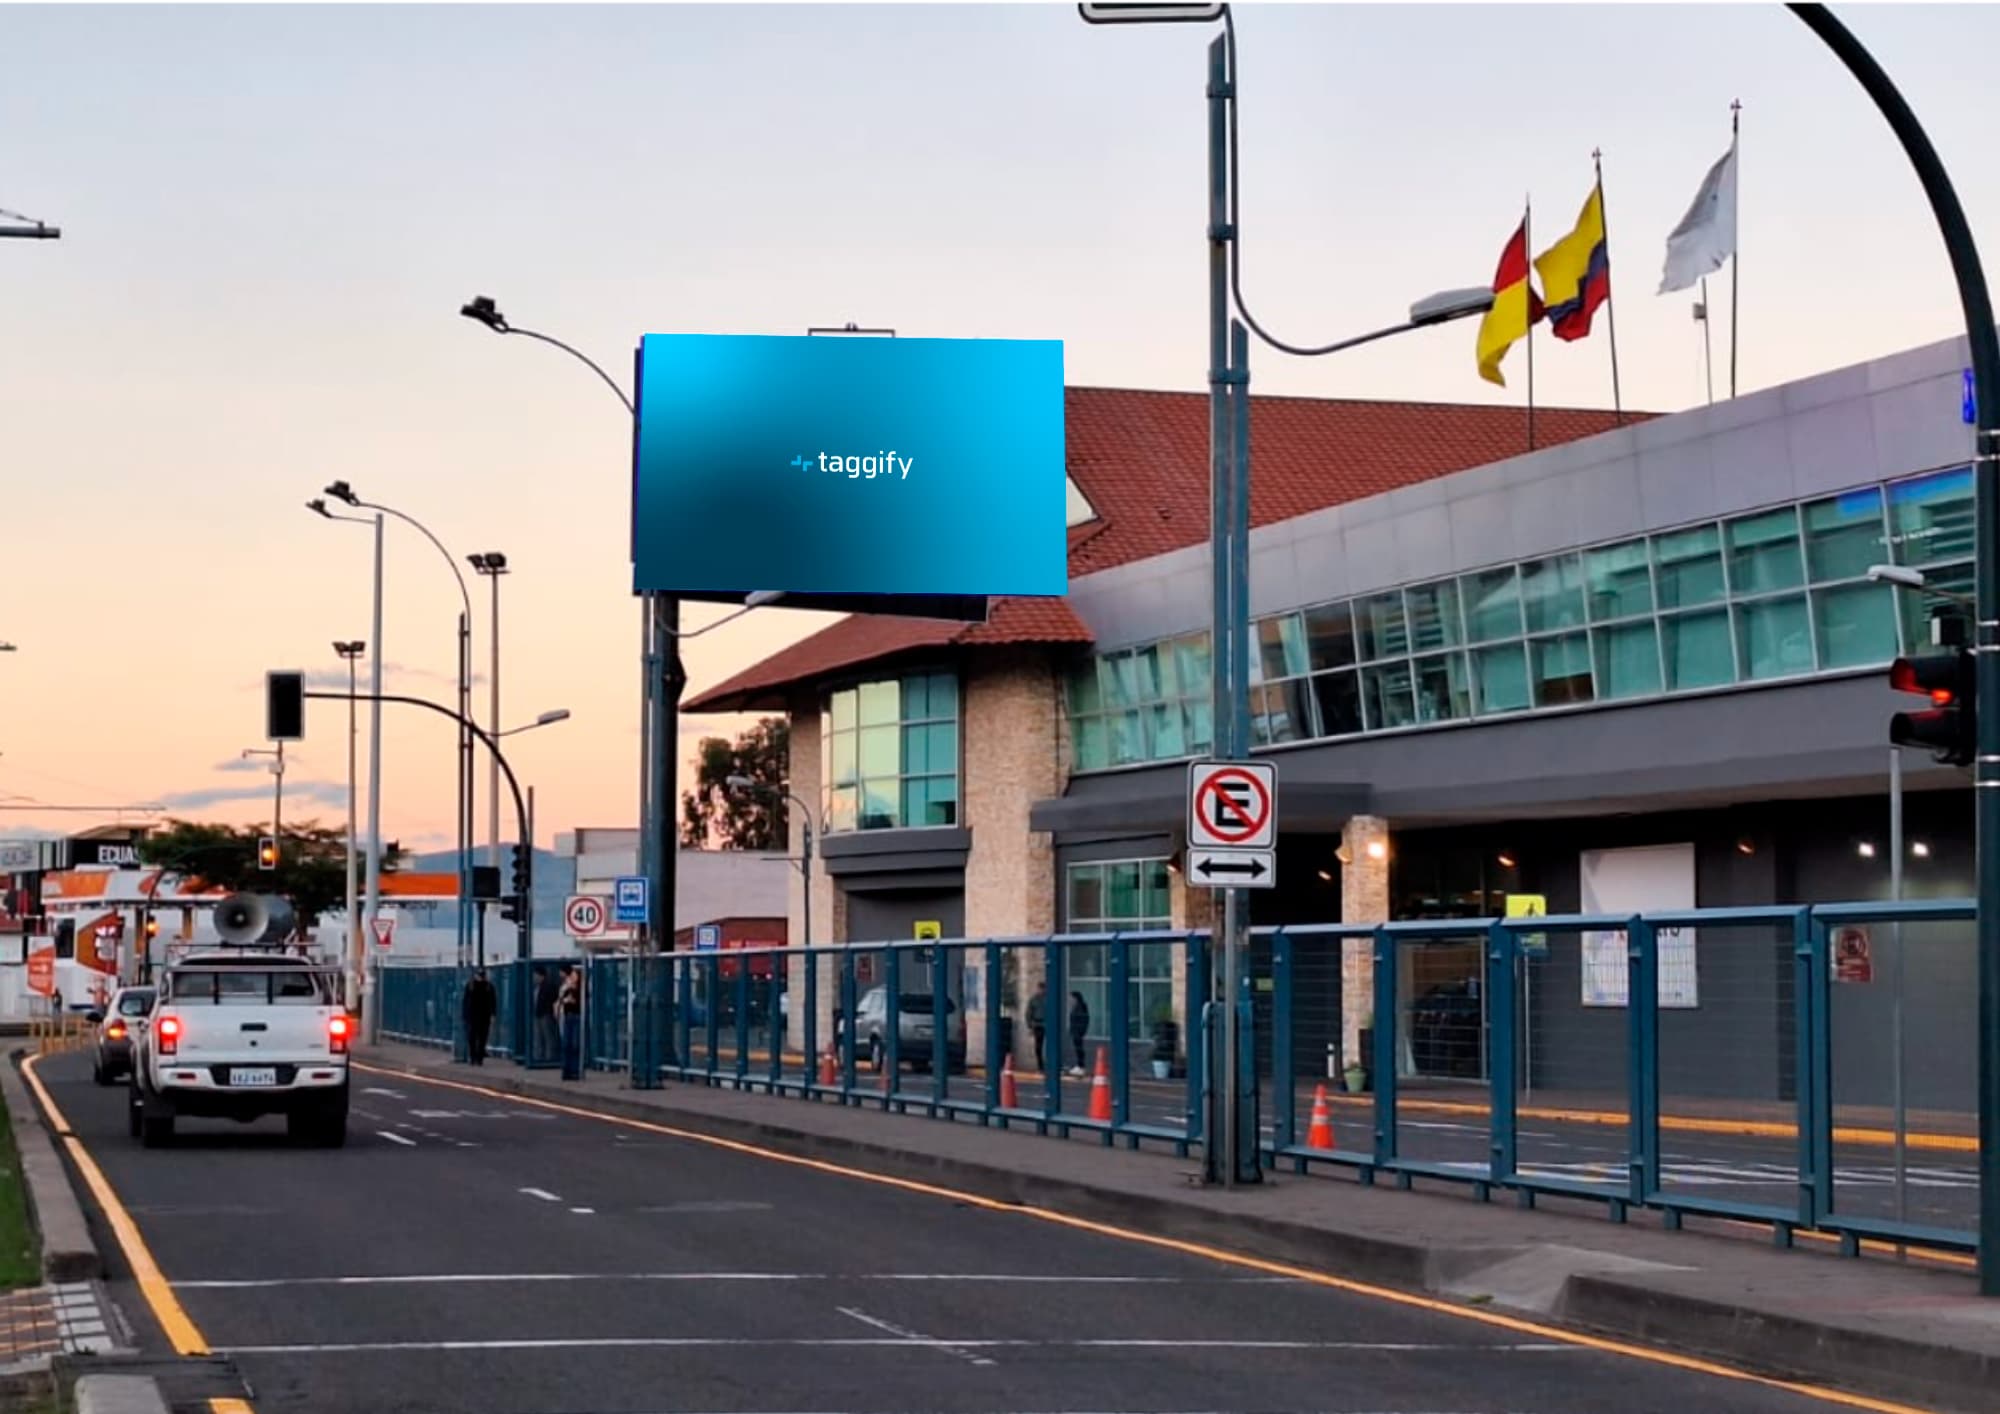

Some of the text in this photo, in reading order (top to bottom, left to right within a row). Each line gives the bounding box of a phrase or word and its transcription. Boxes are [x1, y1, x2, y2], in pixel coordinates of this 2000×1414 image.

[818, 451, 913, 479] taggify
[1215, 783, 1250, 826] E
[574, 906, 597, 924] 40
